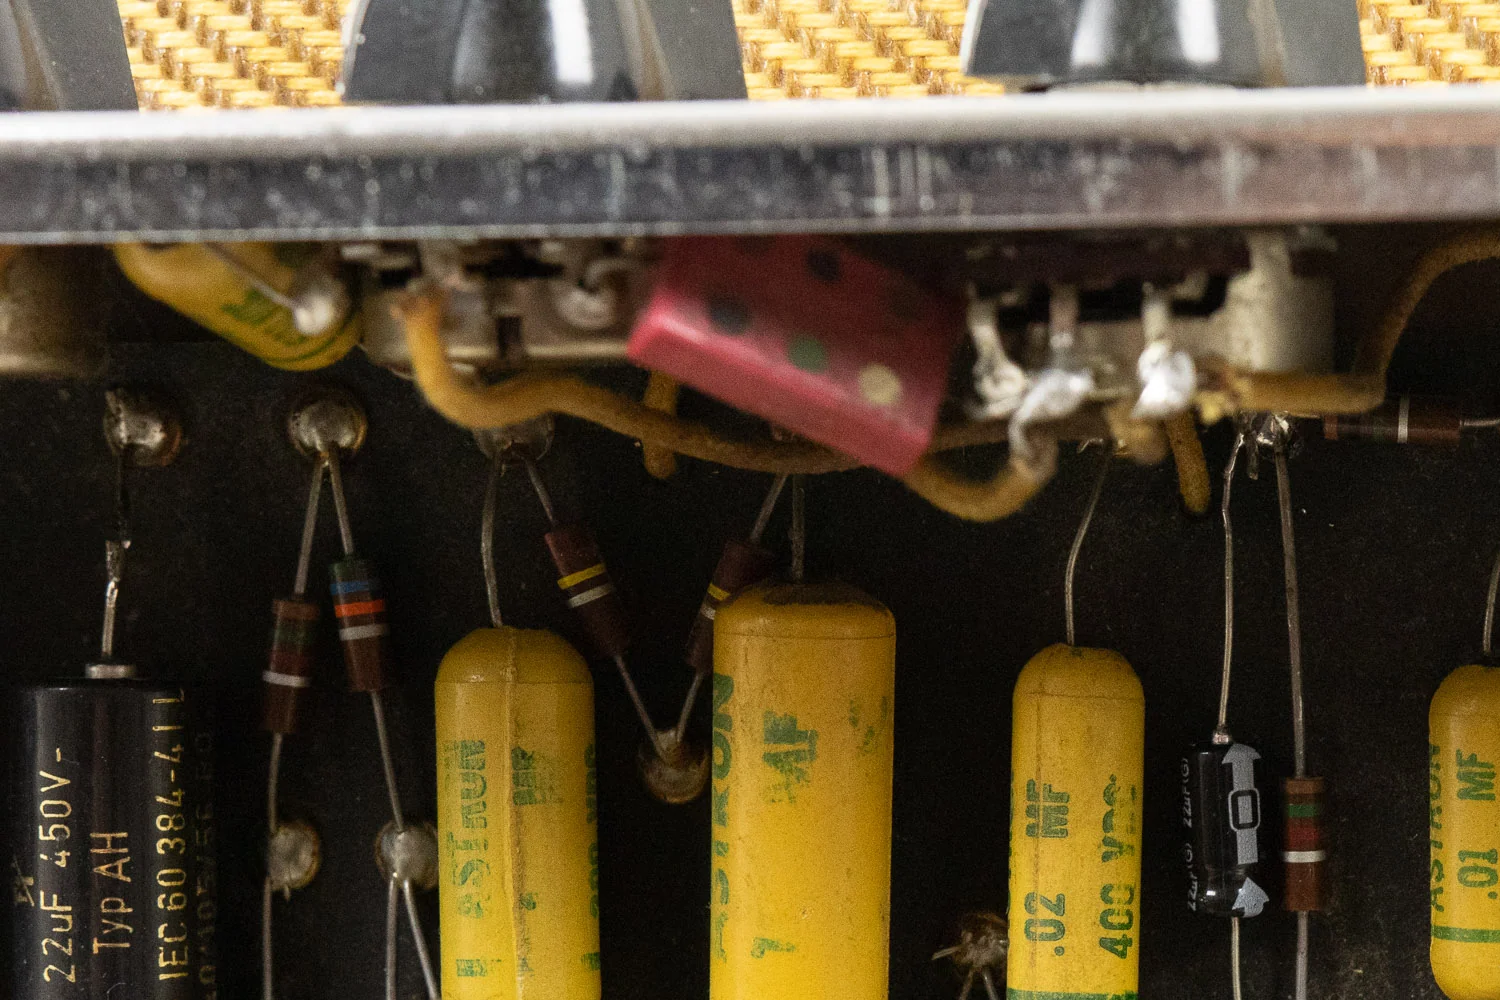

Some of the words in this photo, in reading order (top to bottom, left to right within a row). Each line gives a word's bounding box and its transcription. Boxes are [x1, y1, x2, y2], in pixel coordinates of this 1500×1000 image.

[1455, 749, 1497, 801] MF
[1025, 779, 1069, 839] MF
[90, 831, 130, 882] AH
[1457, 848, 1499, 900] .01
[40, 890, 75, 982] 22uF
[93, 897, 133, 953] Typ
[157, 922, 188, 979] IEC
[1024, 893, 1066, 956] .02
